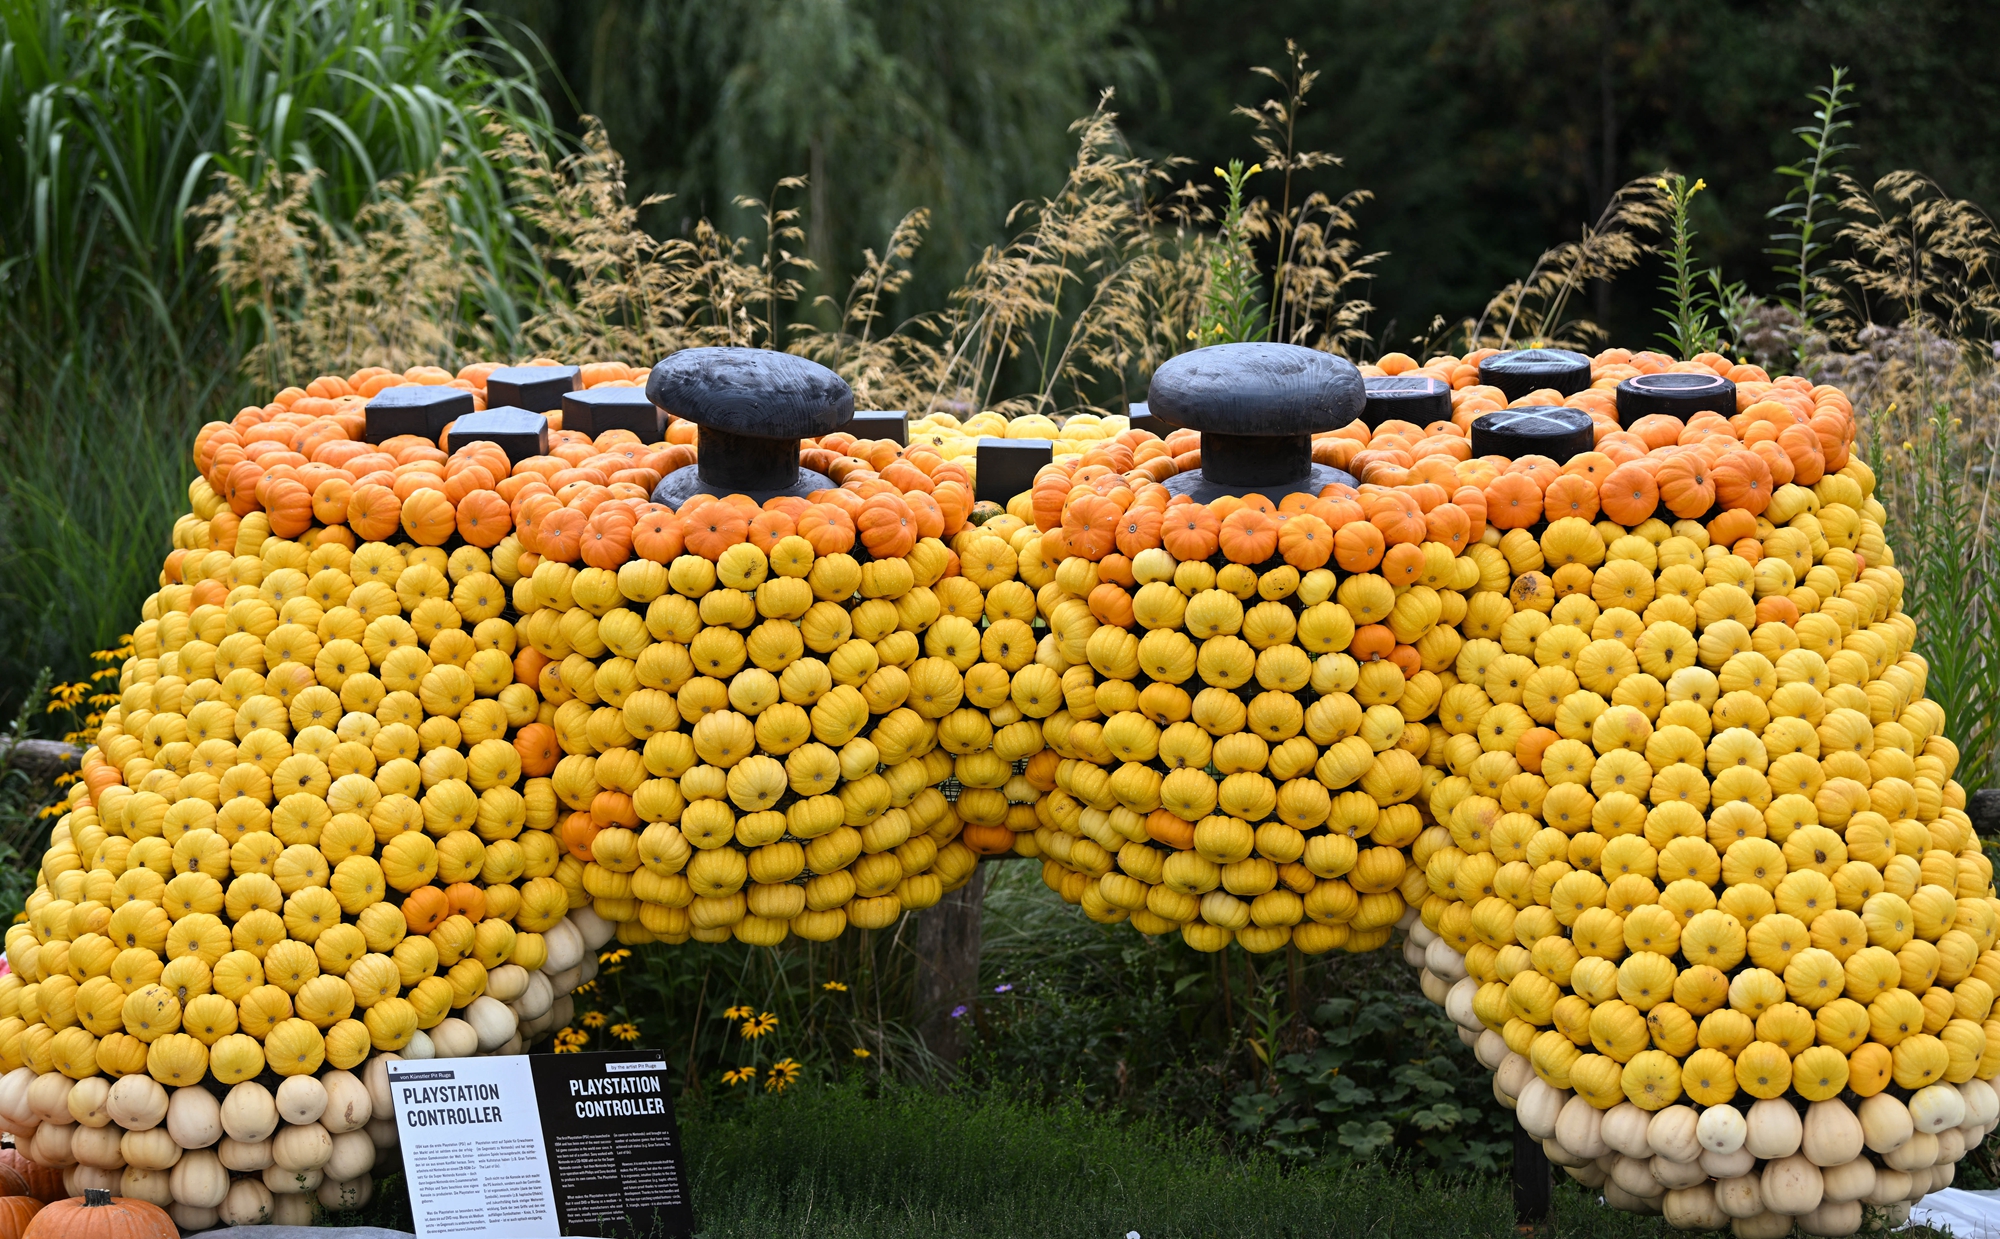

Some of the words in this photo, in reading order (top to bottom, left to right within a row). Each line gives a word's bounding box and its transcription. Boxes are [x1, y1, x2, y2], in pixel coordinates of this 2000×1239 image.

[403, 1084, 500, 1104] PLAYSTATION
[569, 1076, 660, 1096] PLAYSTATION
[407, 1106, 502, 1128] CONTROLLER
[575, 1098, 665, 1118] CONTROLLER
